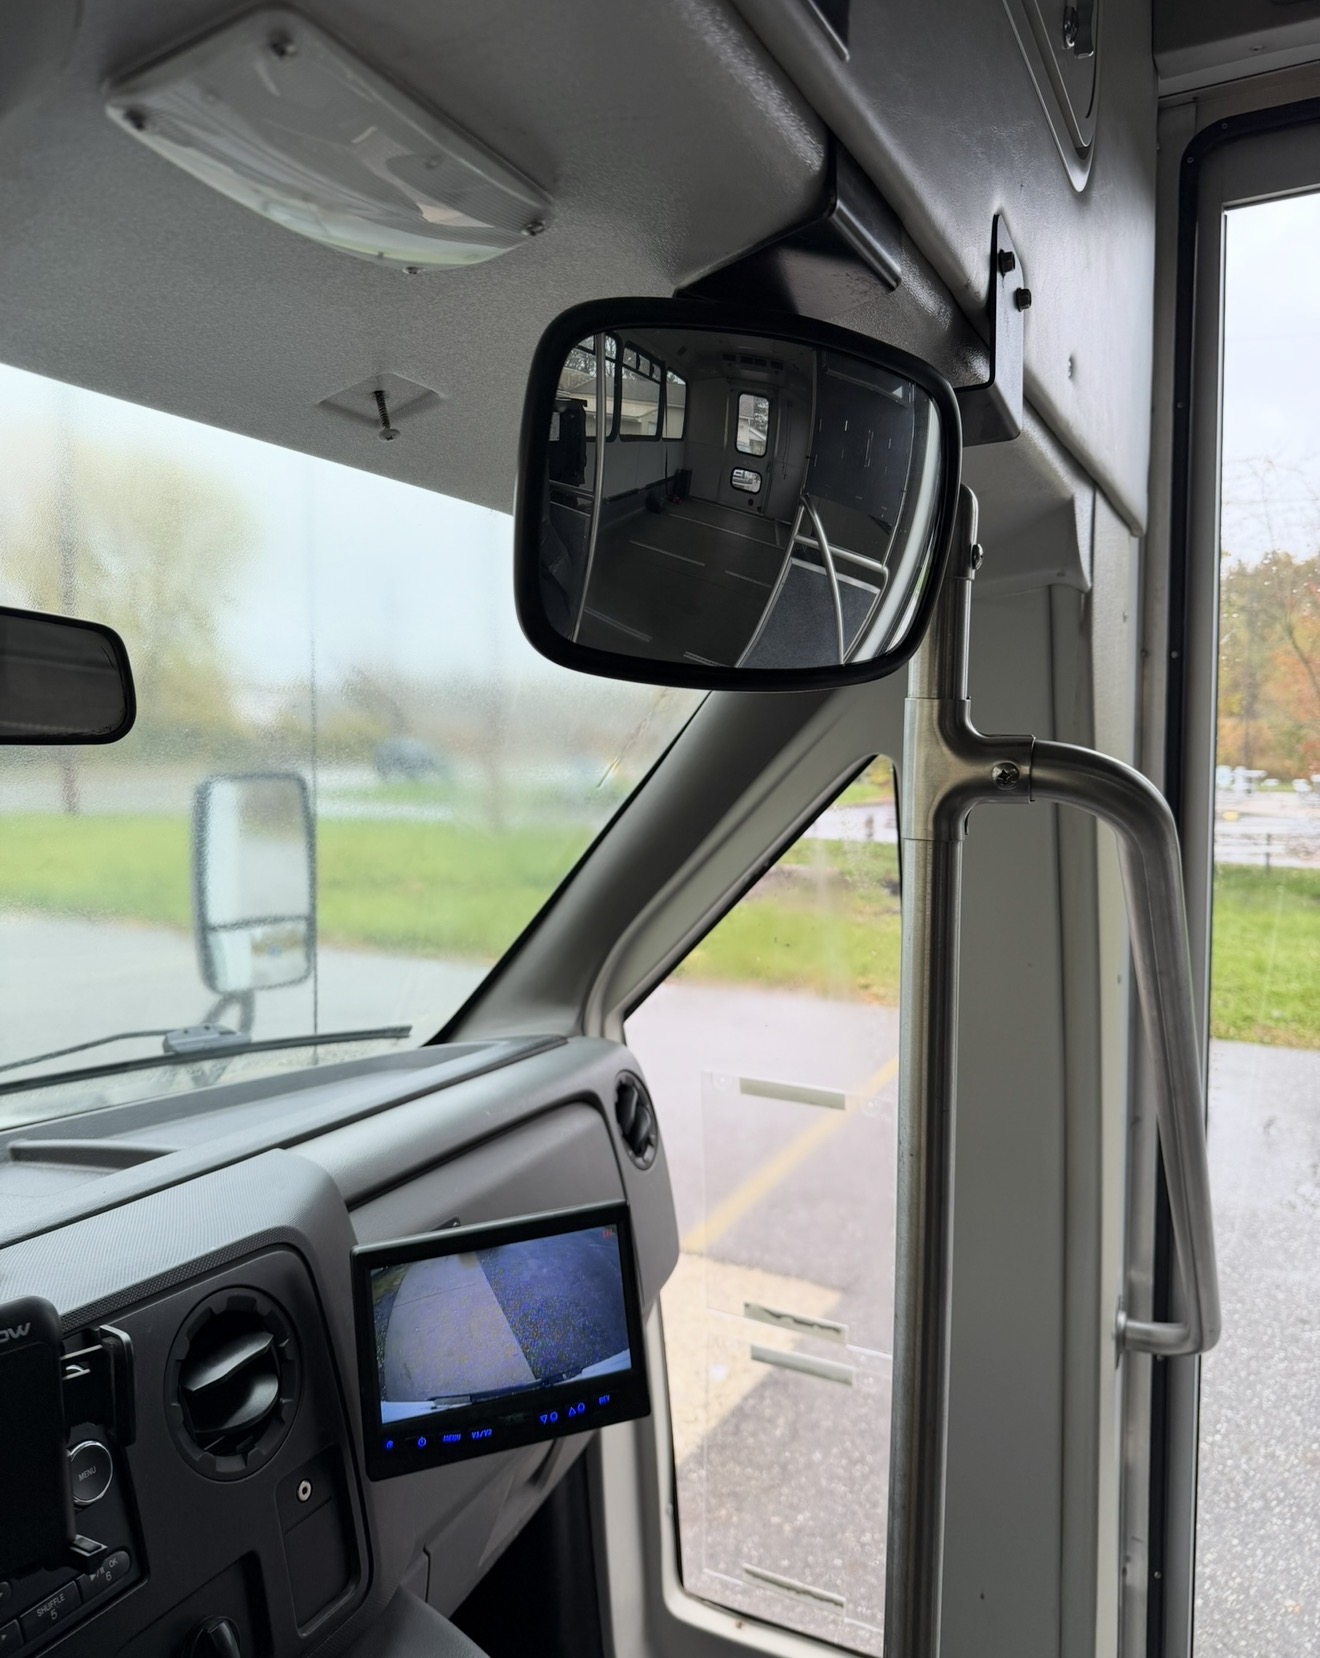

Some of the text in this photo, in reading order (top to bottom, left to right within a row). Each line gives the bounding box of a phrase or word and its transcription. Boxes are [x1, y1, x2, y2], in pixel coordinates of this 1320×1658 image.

[77, 1465, 97, 1482] MENU
[108, 1557, 119, 1568] OK
[105, 1570, 112, 1582] 6
[36, 1593, 65, 1617] SHUFFLE
[50, 1608, 58, 1620] 5
